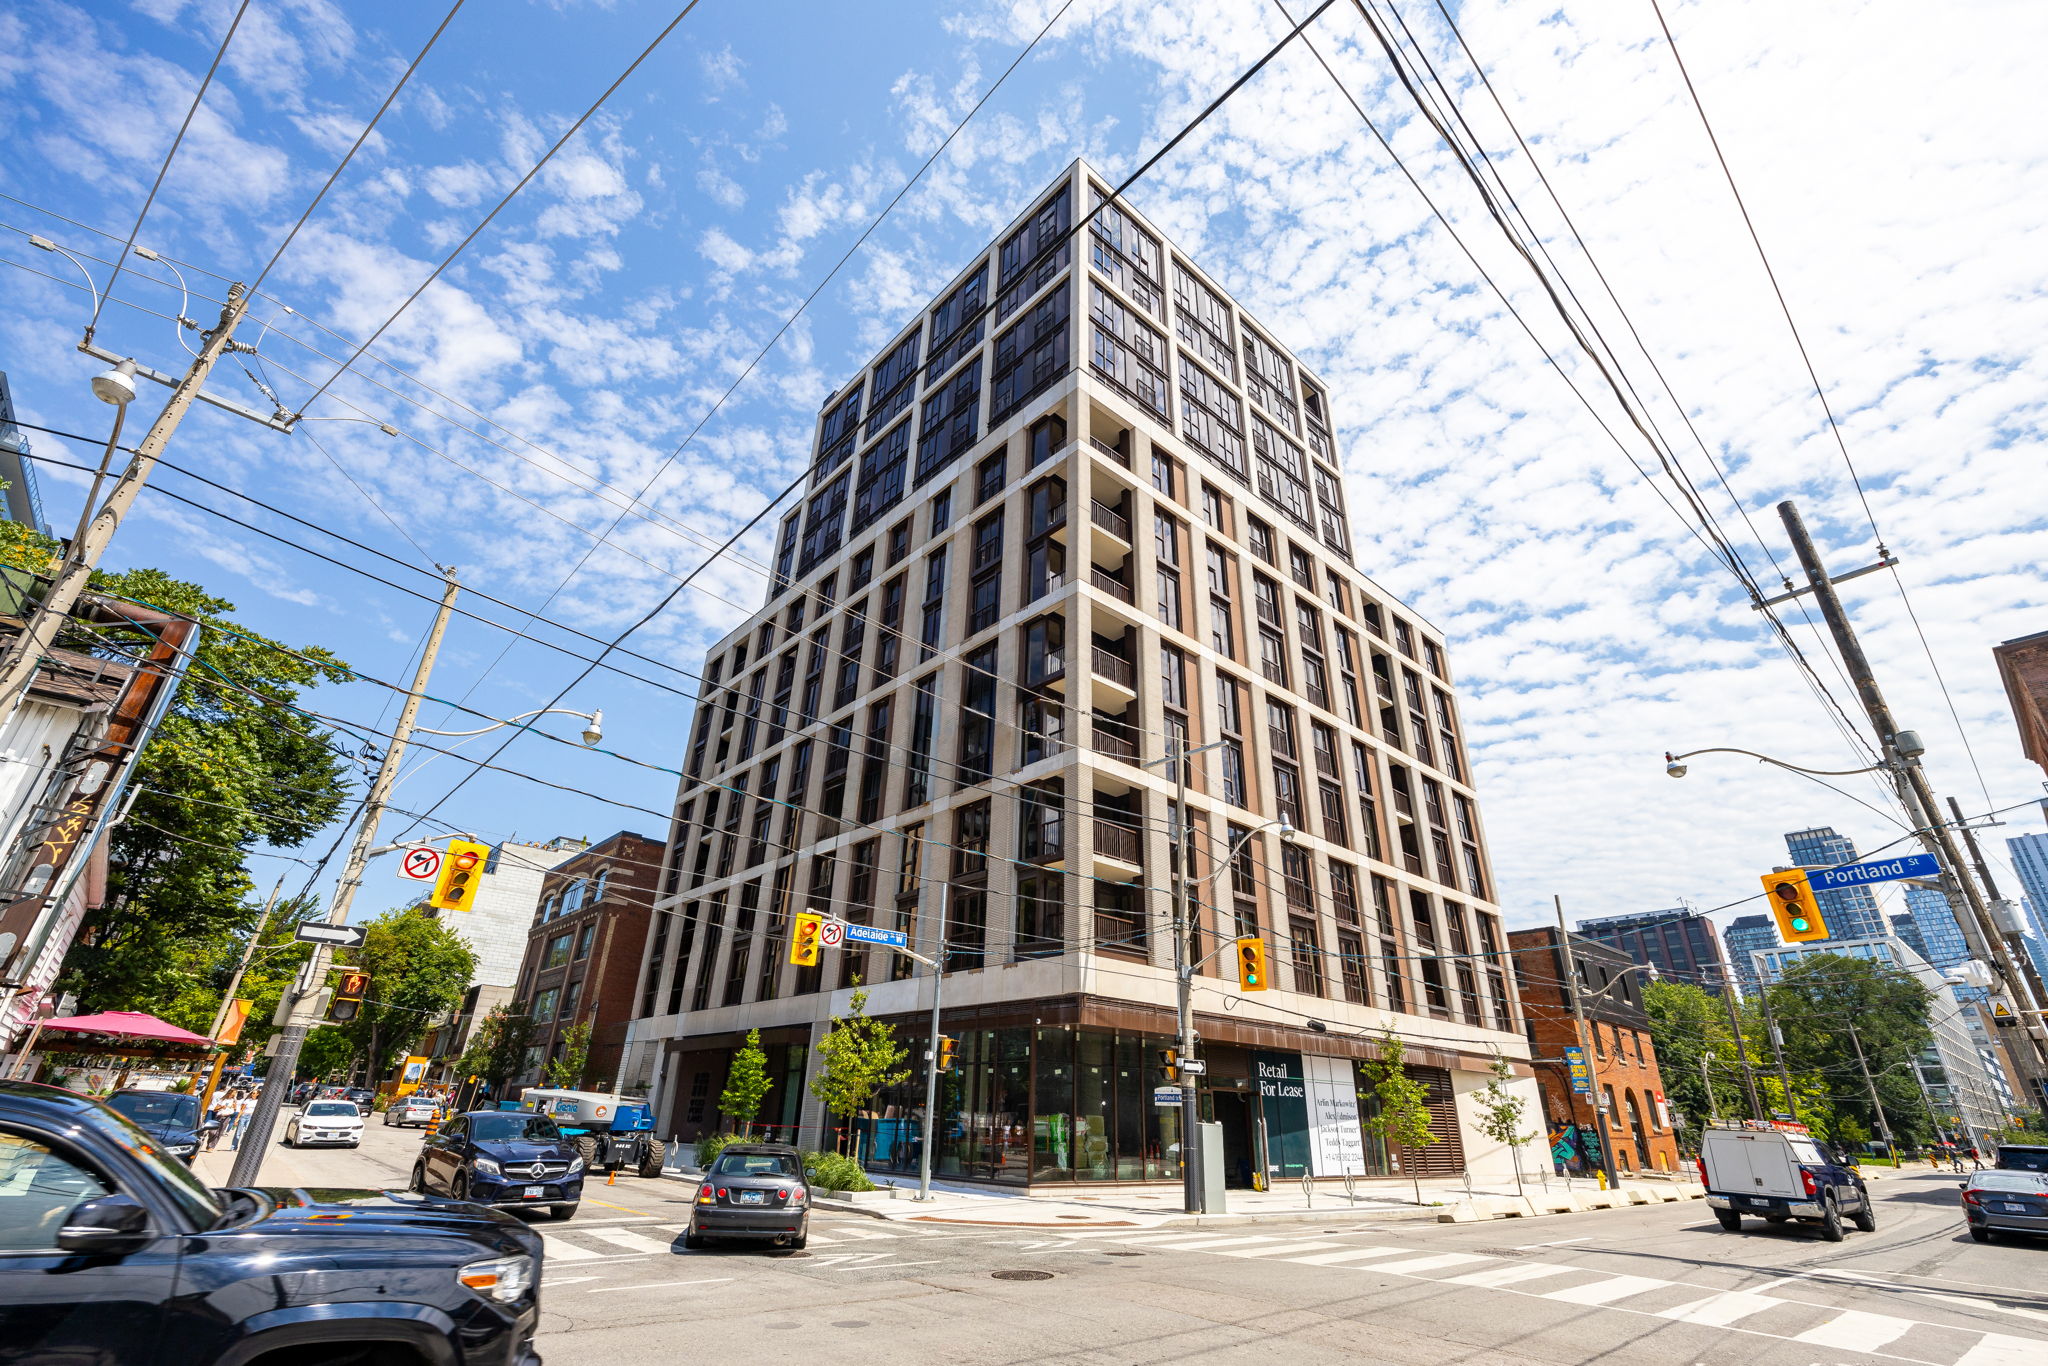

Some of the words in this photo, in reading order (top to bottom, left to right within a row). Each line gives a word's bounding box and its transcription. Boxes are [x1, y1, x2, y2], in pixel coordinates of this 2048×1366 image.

[1823, 860, 1904, 885] Portland
[1907, 857, 1920, 866] St
[850, 926, 889, 942] Adelaide
[1258, 1061, 1288, 1079] Retail
[1260, 1080, 1276, 1097] For
[1278, 1081, 1304, 1098] Lease
[556, 1101, 578, 1113] Genie
